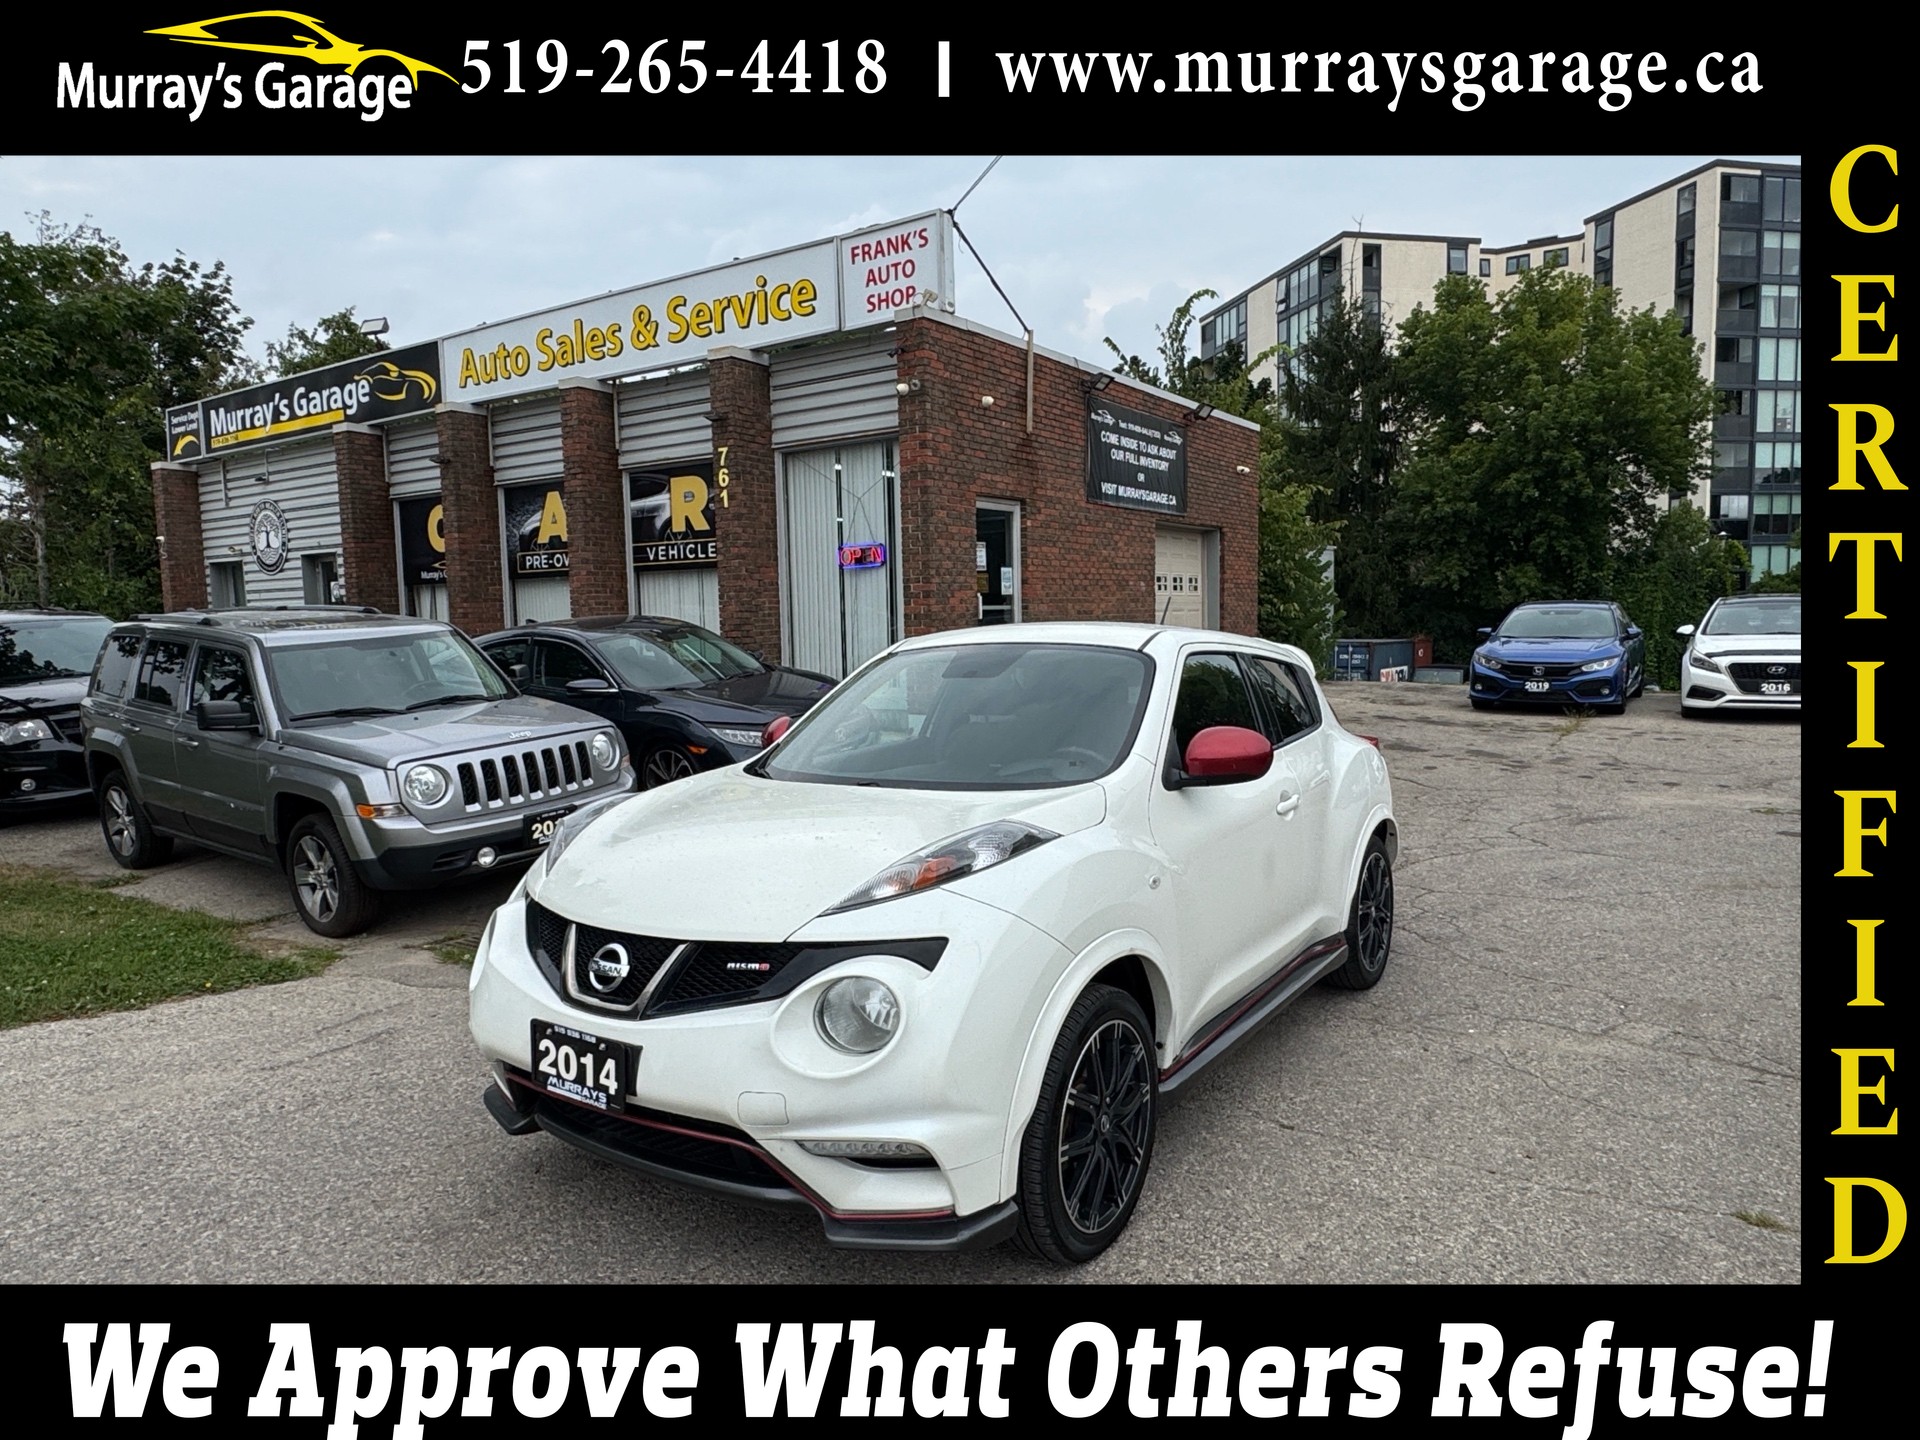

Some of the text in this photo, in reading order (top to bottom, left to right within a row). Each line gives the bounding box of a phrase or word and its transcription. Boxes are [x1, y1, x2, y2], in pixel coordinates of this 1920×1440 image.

[850, 228, 929, 265] FRANK'S
[865, 259, 916, 288] AUTO
[866, 285, 917, 313] SHOP
[459, 275, 817, 388] Auto Sales & Service
[210, 379, 370, 434] Murray's Garage
[1101, 431, 1176, 459] COME INSIDE TO ASK ABOUT
[1110, 448, 1169, 471] OUR FULL INVENTORY
[718, 446, 730, 508] 761
[1100, 481, 1118, 496] VISIT
[1137, 472, 1145, 483] OR
[537, 490, 569, 545] A
[669, 475, 711, 532] R
[841, 547, 883, 566] OPEN
[1524, 681, 1550, 691] 2019
[1760, 683, 1791, 692] 2016
[538, 1038, 618, 1095] 2014
[547, 1076, 607, 1103] MURRAYS
